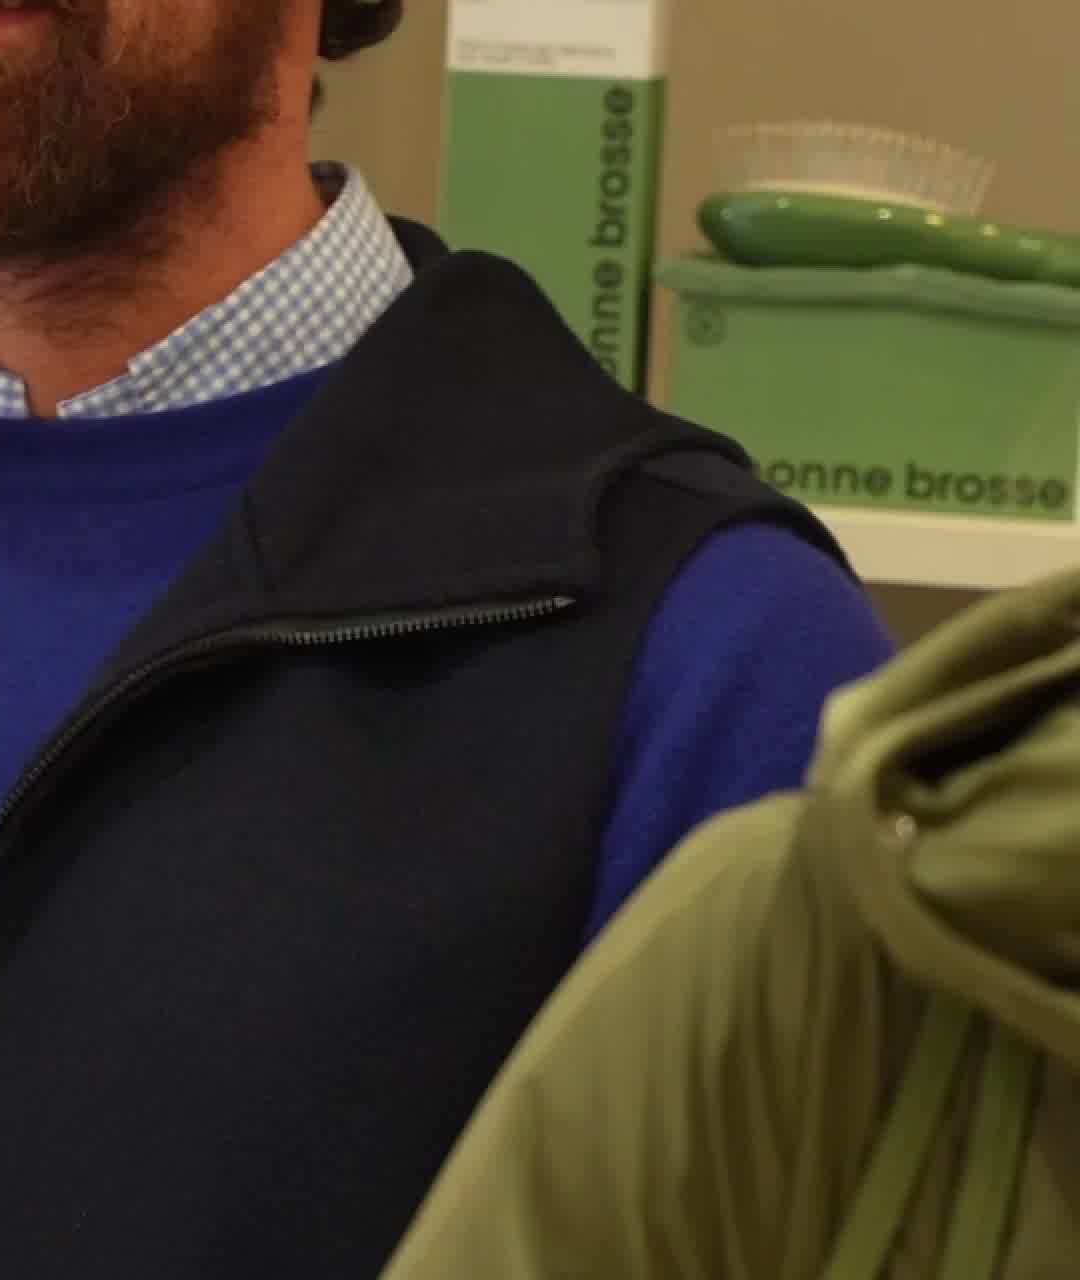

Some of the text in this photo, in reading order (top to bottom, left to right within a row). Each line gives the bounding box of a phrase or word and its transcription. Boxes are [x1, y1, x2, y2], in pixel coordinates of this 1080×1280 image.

[587, 86, 635, 248] brosse
[762, 460, 1068, 510] onne brosse
